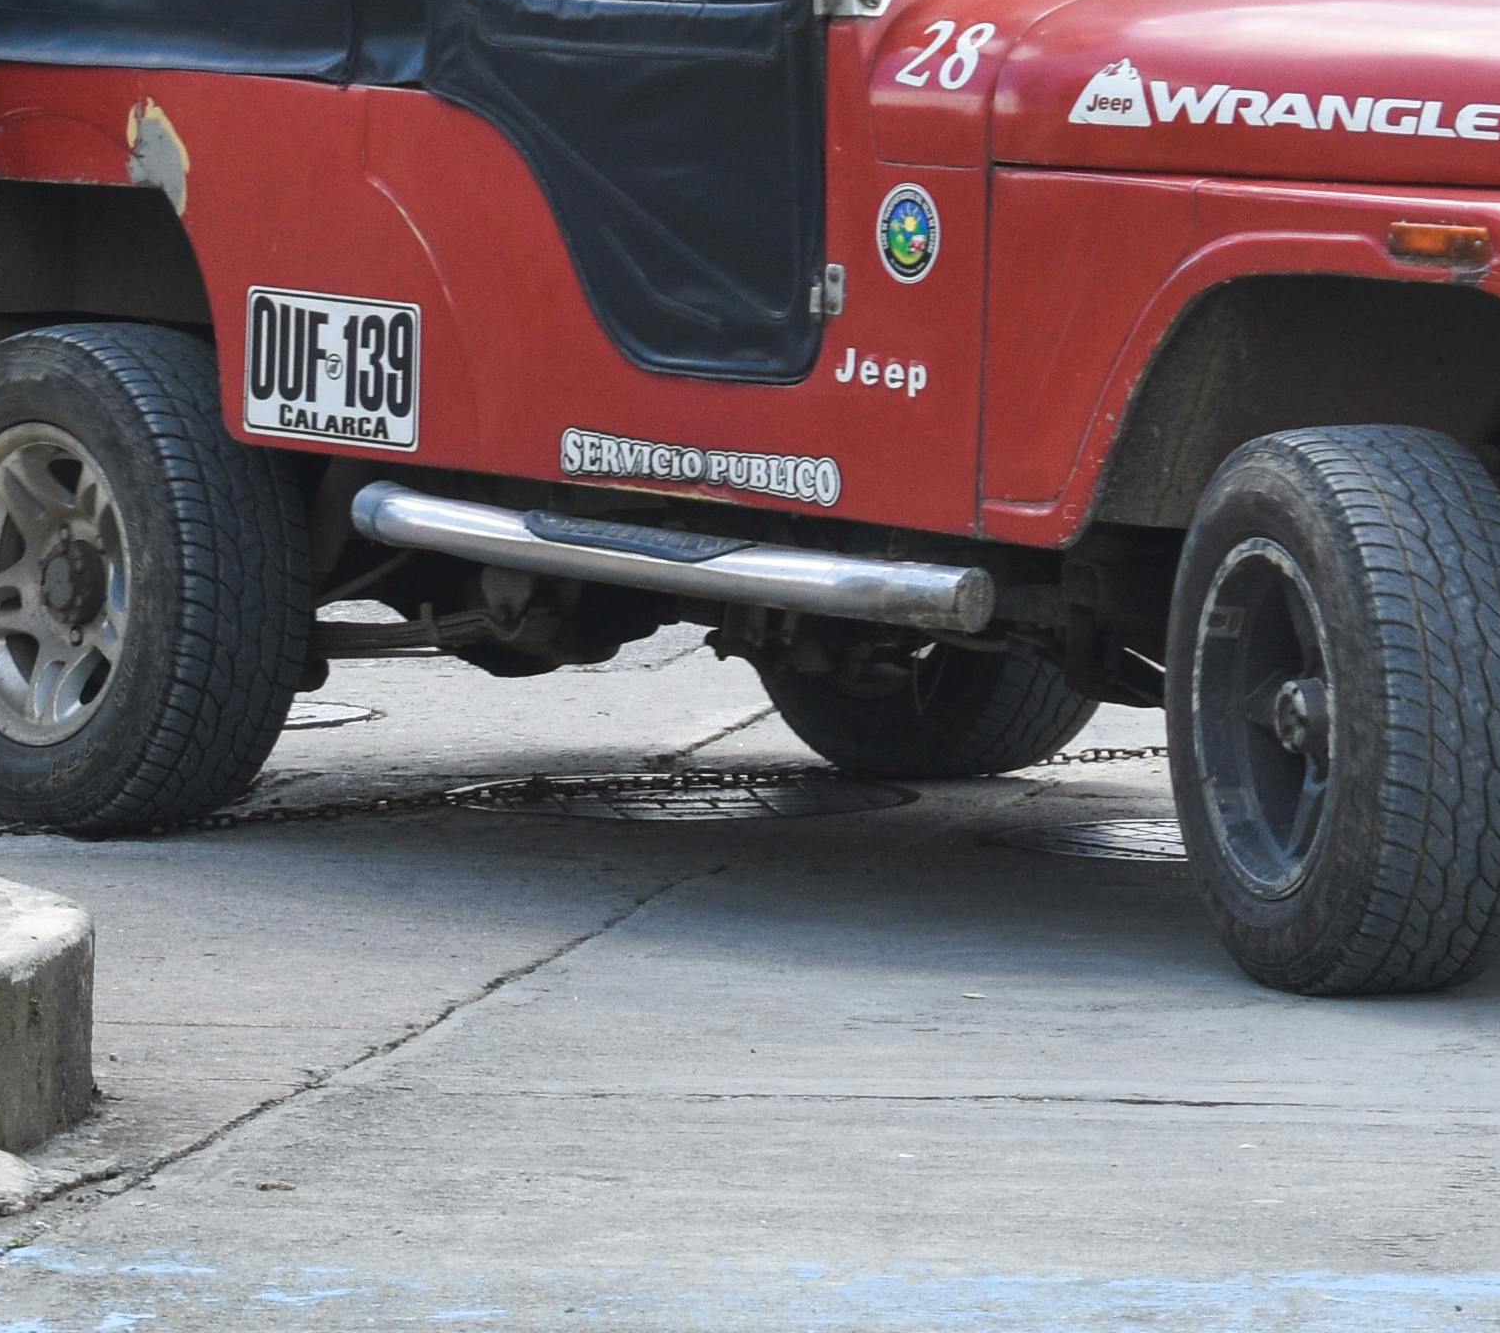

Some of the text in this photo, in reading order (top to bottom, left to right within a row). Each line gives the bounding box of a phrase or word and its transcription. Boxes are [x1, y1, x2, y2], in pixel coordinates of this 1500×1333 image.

[895, 20, 994, 90] 28
[1086, 93, 1133, 114] Jeep
[835, 348, 927, 397] Jeep
[279, 404, 389, 439] CALARCA
[707, 452, 841, 506] PUBLICO
